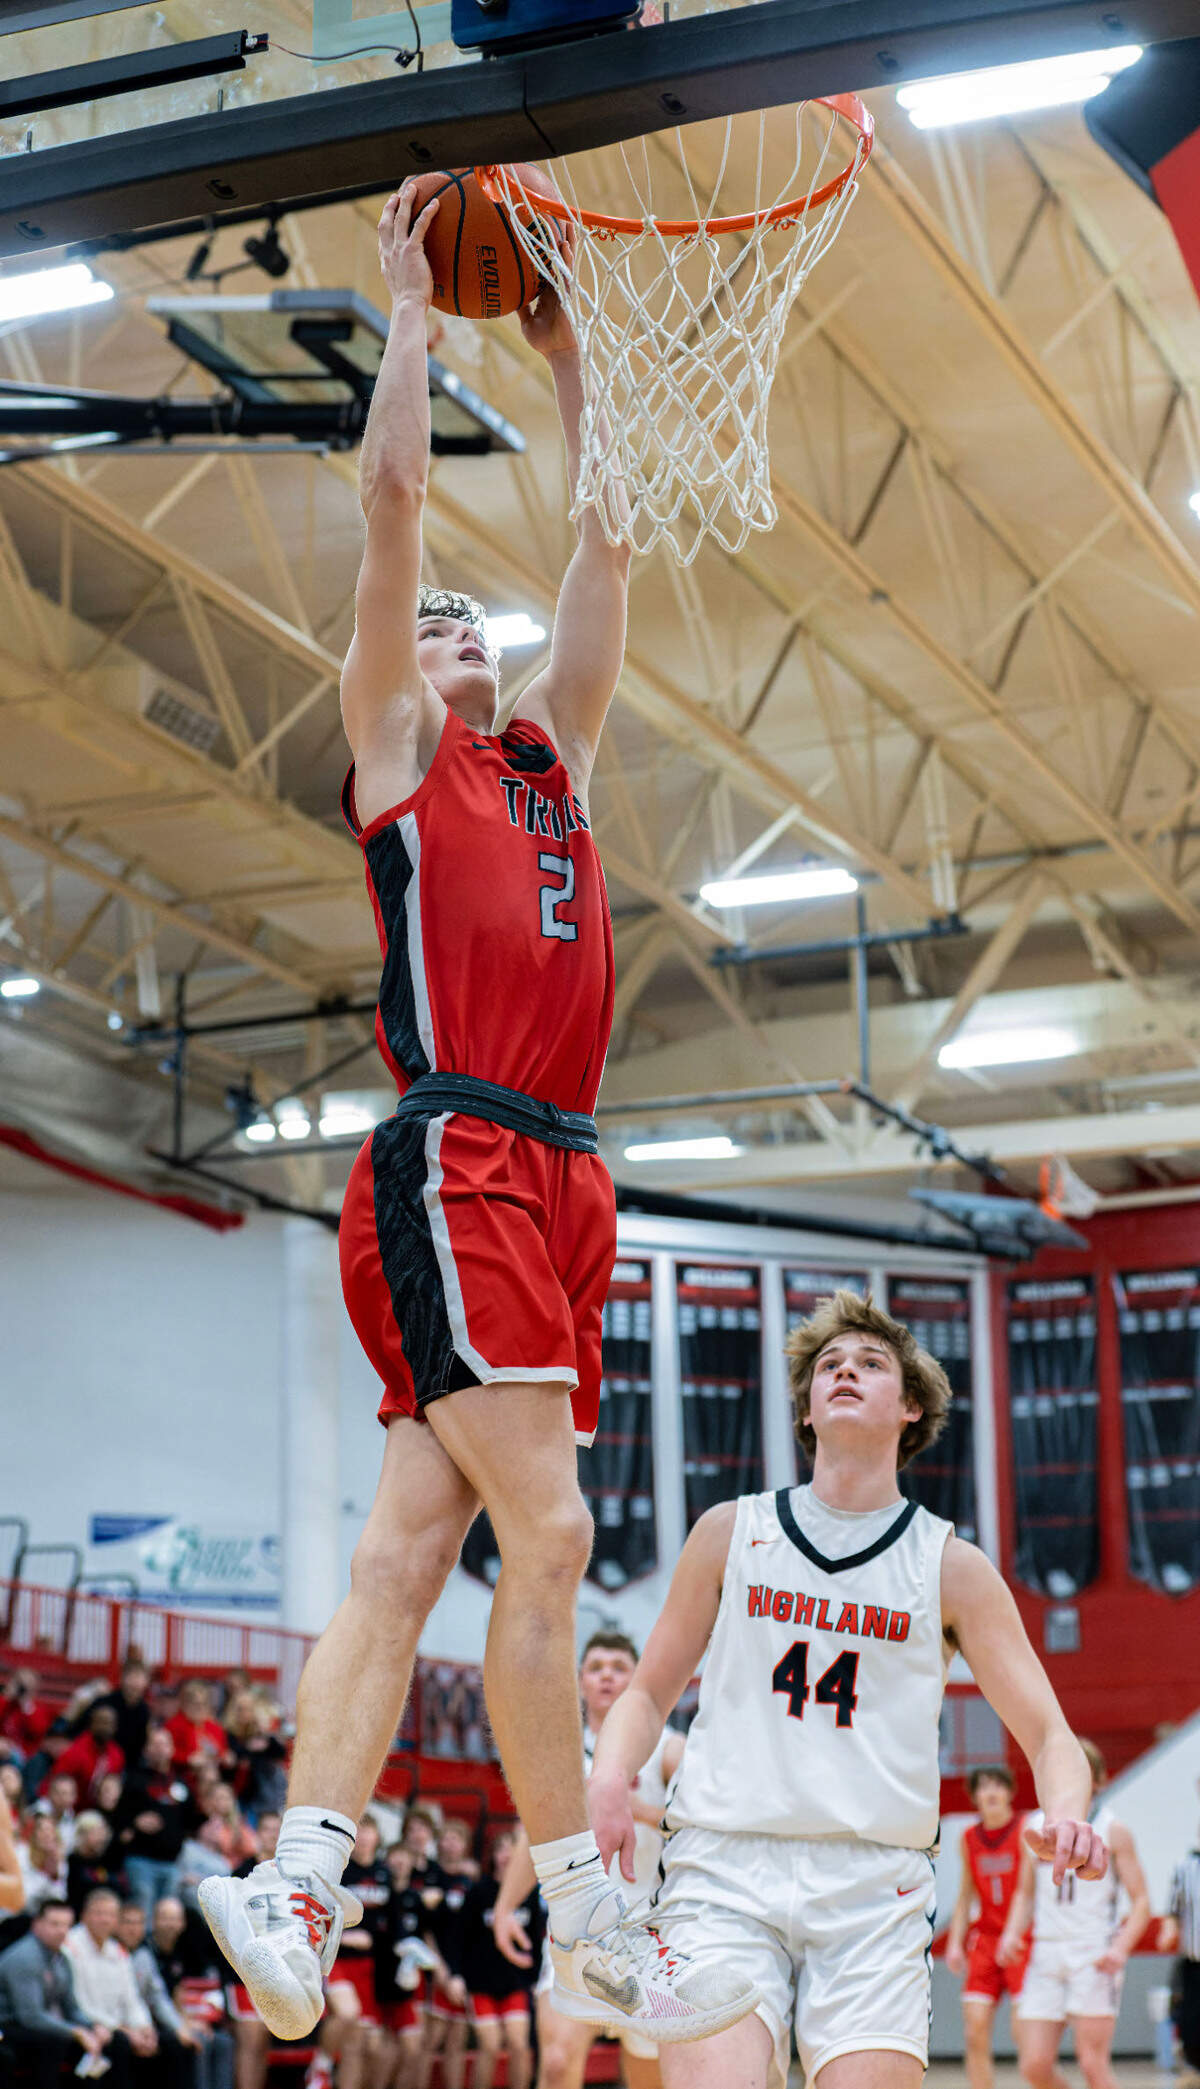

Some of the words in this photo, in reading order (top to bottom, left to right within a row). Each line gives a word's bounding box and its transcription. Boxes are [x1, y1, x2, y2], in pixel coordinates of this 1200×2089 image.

[537, 851, 579, 942] 2
[747, 1584, 912, 1643] HIGHLAND
[772, 1640, 861, 1729] 44
